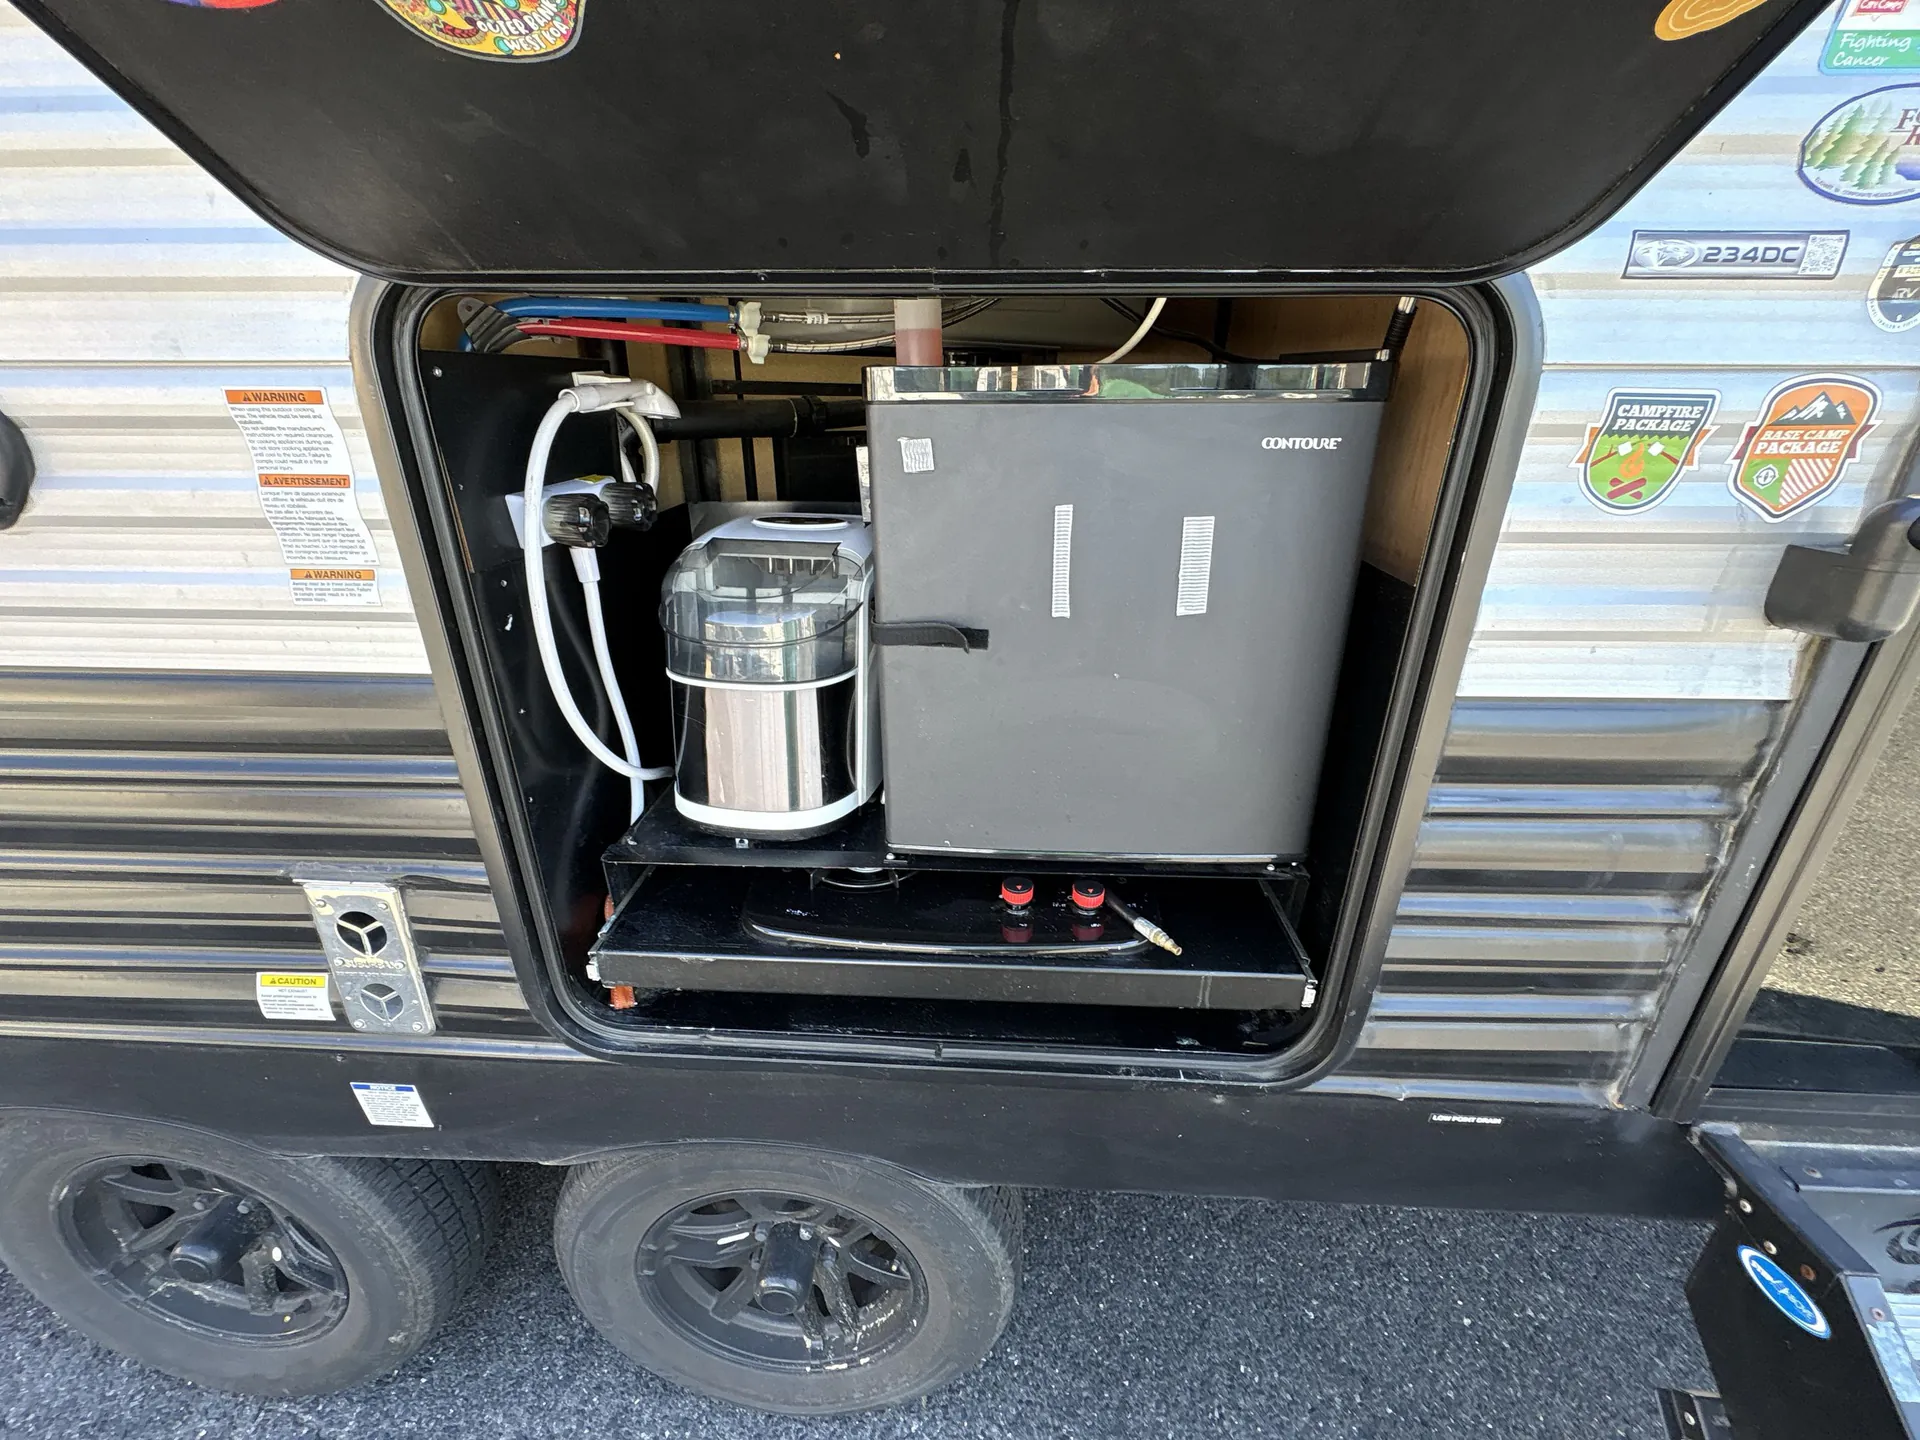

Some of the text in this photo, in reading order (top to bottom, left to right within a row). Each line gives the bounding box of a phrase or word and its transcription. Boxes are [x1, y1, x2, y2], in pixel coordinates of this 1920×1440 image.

[476, 18, 529, 36] OUTER
[503, 20, 569, 51] WEST KOA
[1840, 32, 1912, 52] Fighting
[1833, 51, 1890, 67] Cancer
[1702, 246, 1800, 263] 234DC
[251, 392, 306, 402] WARNING
[1617, 404, 1704, 419] CAMPFIRE
[1612, 418, 1697, 431] PACKAGE
[1761, 429, 1850, 441] BASE CAMP
[1261, 437, 1339, 450] CONTOURE
[1754, 441, 1844, 454] PACKAGE
[273, 477, 347, 486] AVERTISSEMENT
[314, 571, 362, 579] WARNING
[1451, 1115, 1476, 1123] POINT
